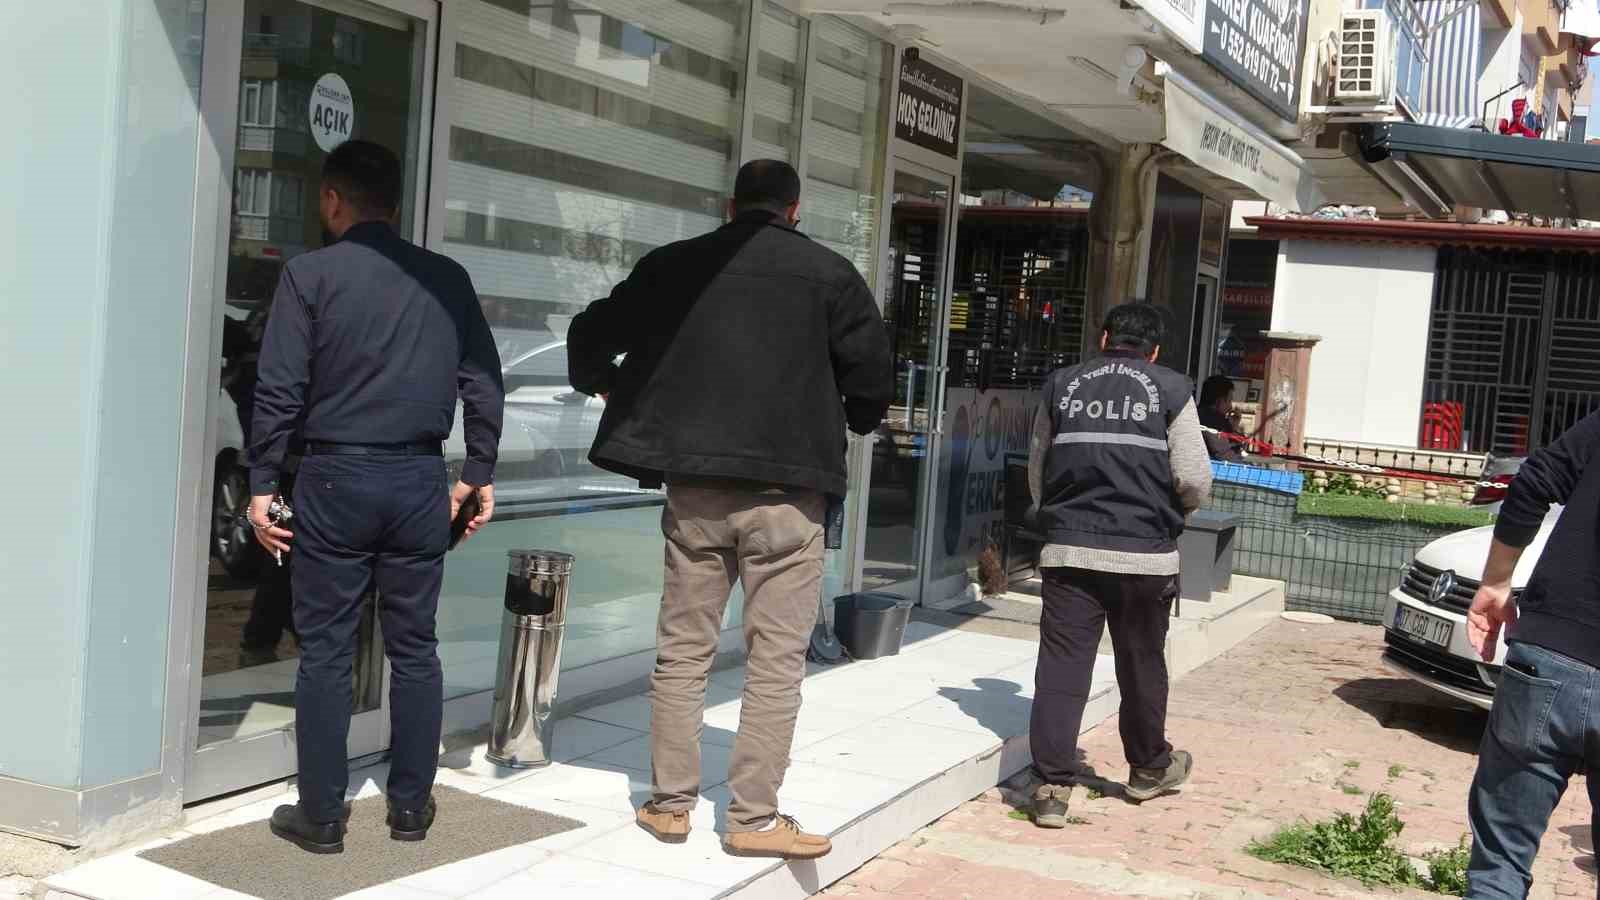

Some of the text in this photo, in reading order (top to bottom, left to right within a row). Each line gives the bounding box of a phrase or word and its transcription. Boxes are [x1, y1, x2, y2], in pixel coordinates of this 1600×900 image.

[1220, 20, 1280, 94] 0 552 819 07 72
[1248, 3, 1295, 70] KUAFÖRÜ
[313, 103, 349, 136] AÇIK
[897, 91, 956, 144] HOŞ GELDİNİZ
[1059, 377, 1081, 410] OLAY
[1116, 362, 1160, 413] İNCELEME
[1067, 394, 1148, 422] POLİS
